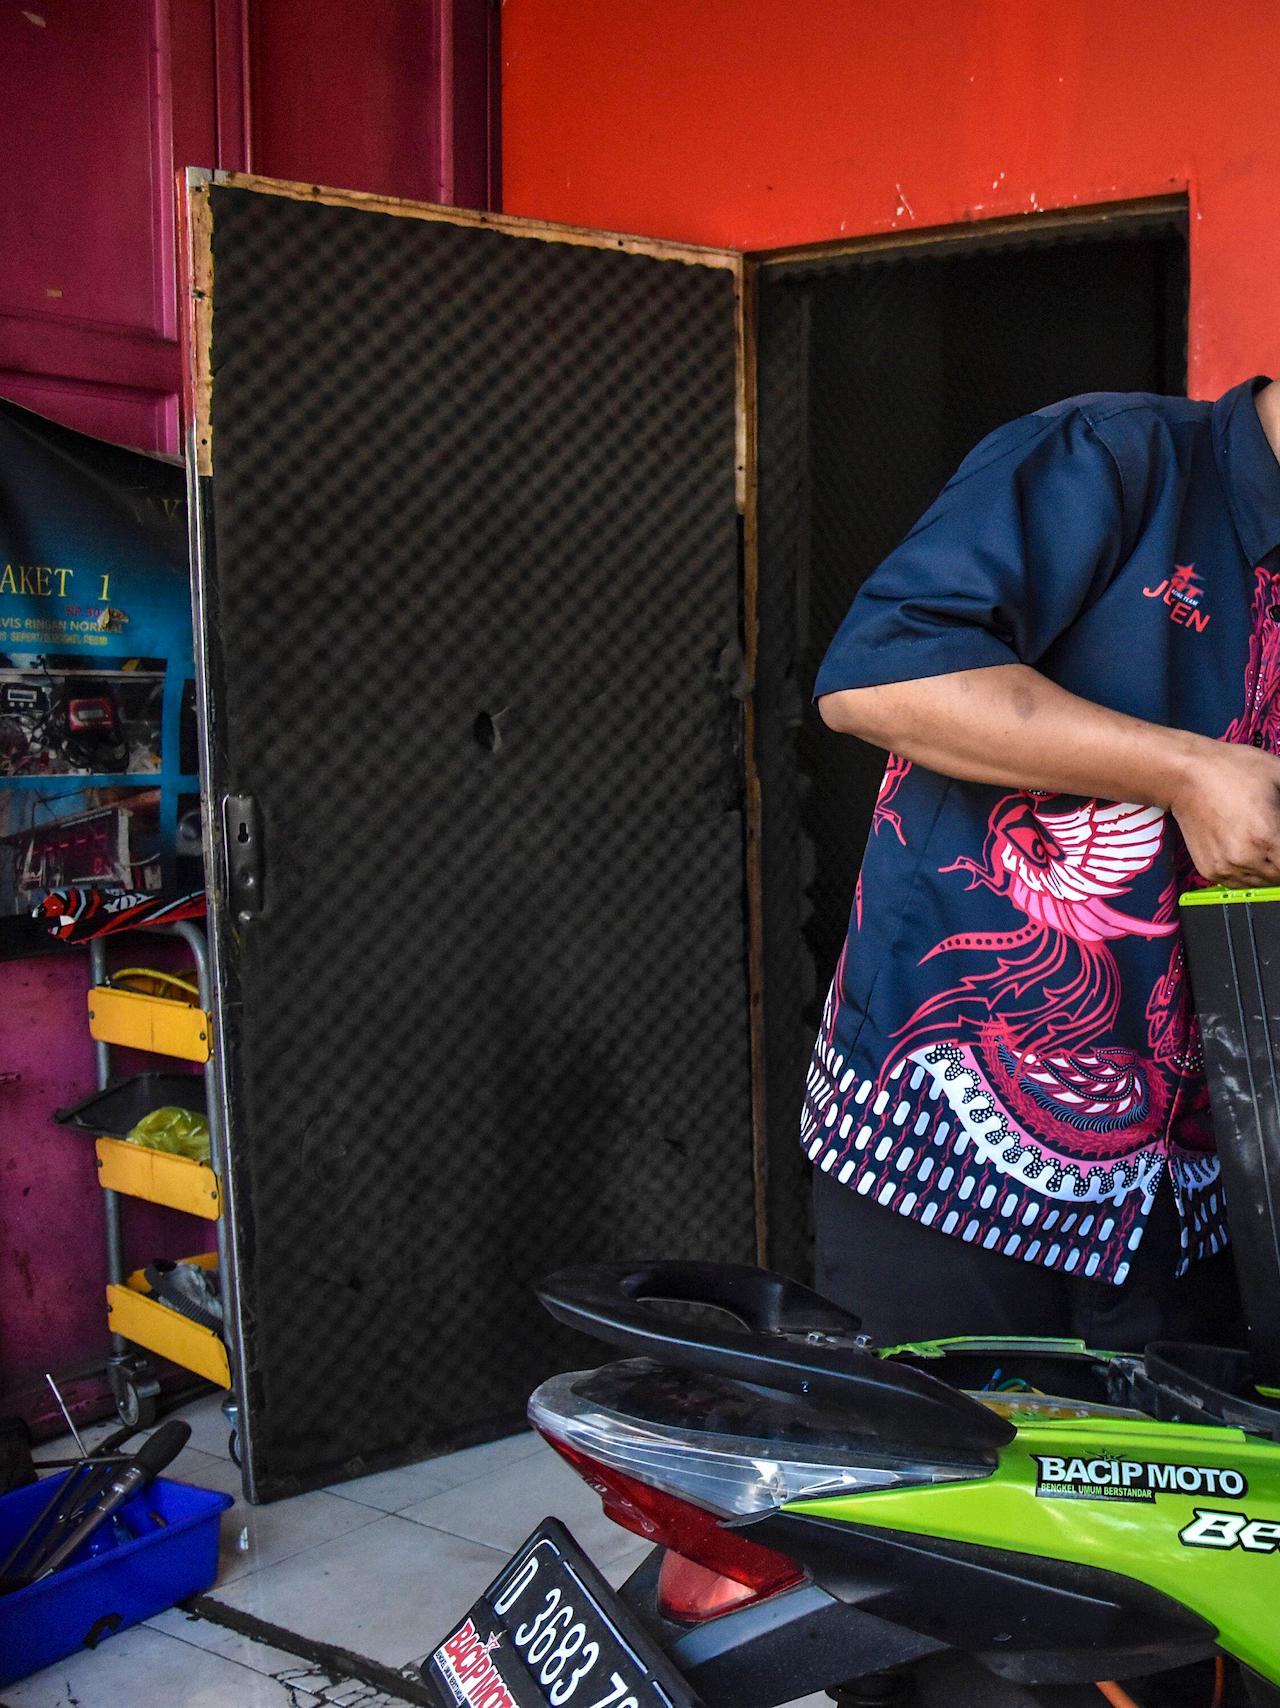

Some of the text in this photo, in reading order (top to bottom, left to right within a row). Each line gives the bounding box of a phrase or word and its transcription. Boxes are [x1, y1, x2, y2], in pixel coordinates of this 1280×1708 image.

[1038, 1456, 1244, 1496] BACIP MOTO
[1040, 1482, 1152, 1499] BENGKEL UMUM BERSTANDAR
[494, 1556, 539, 1615] D
[444, 1621, 490, 1684] BACIP
[515, 1588, 600, 1706] 3683
